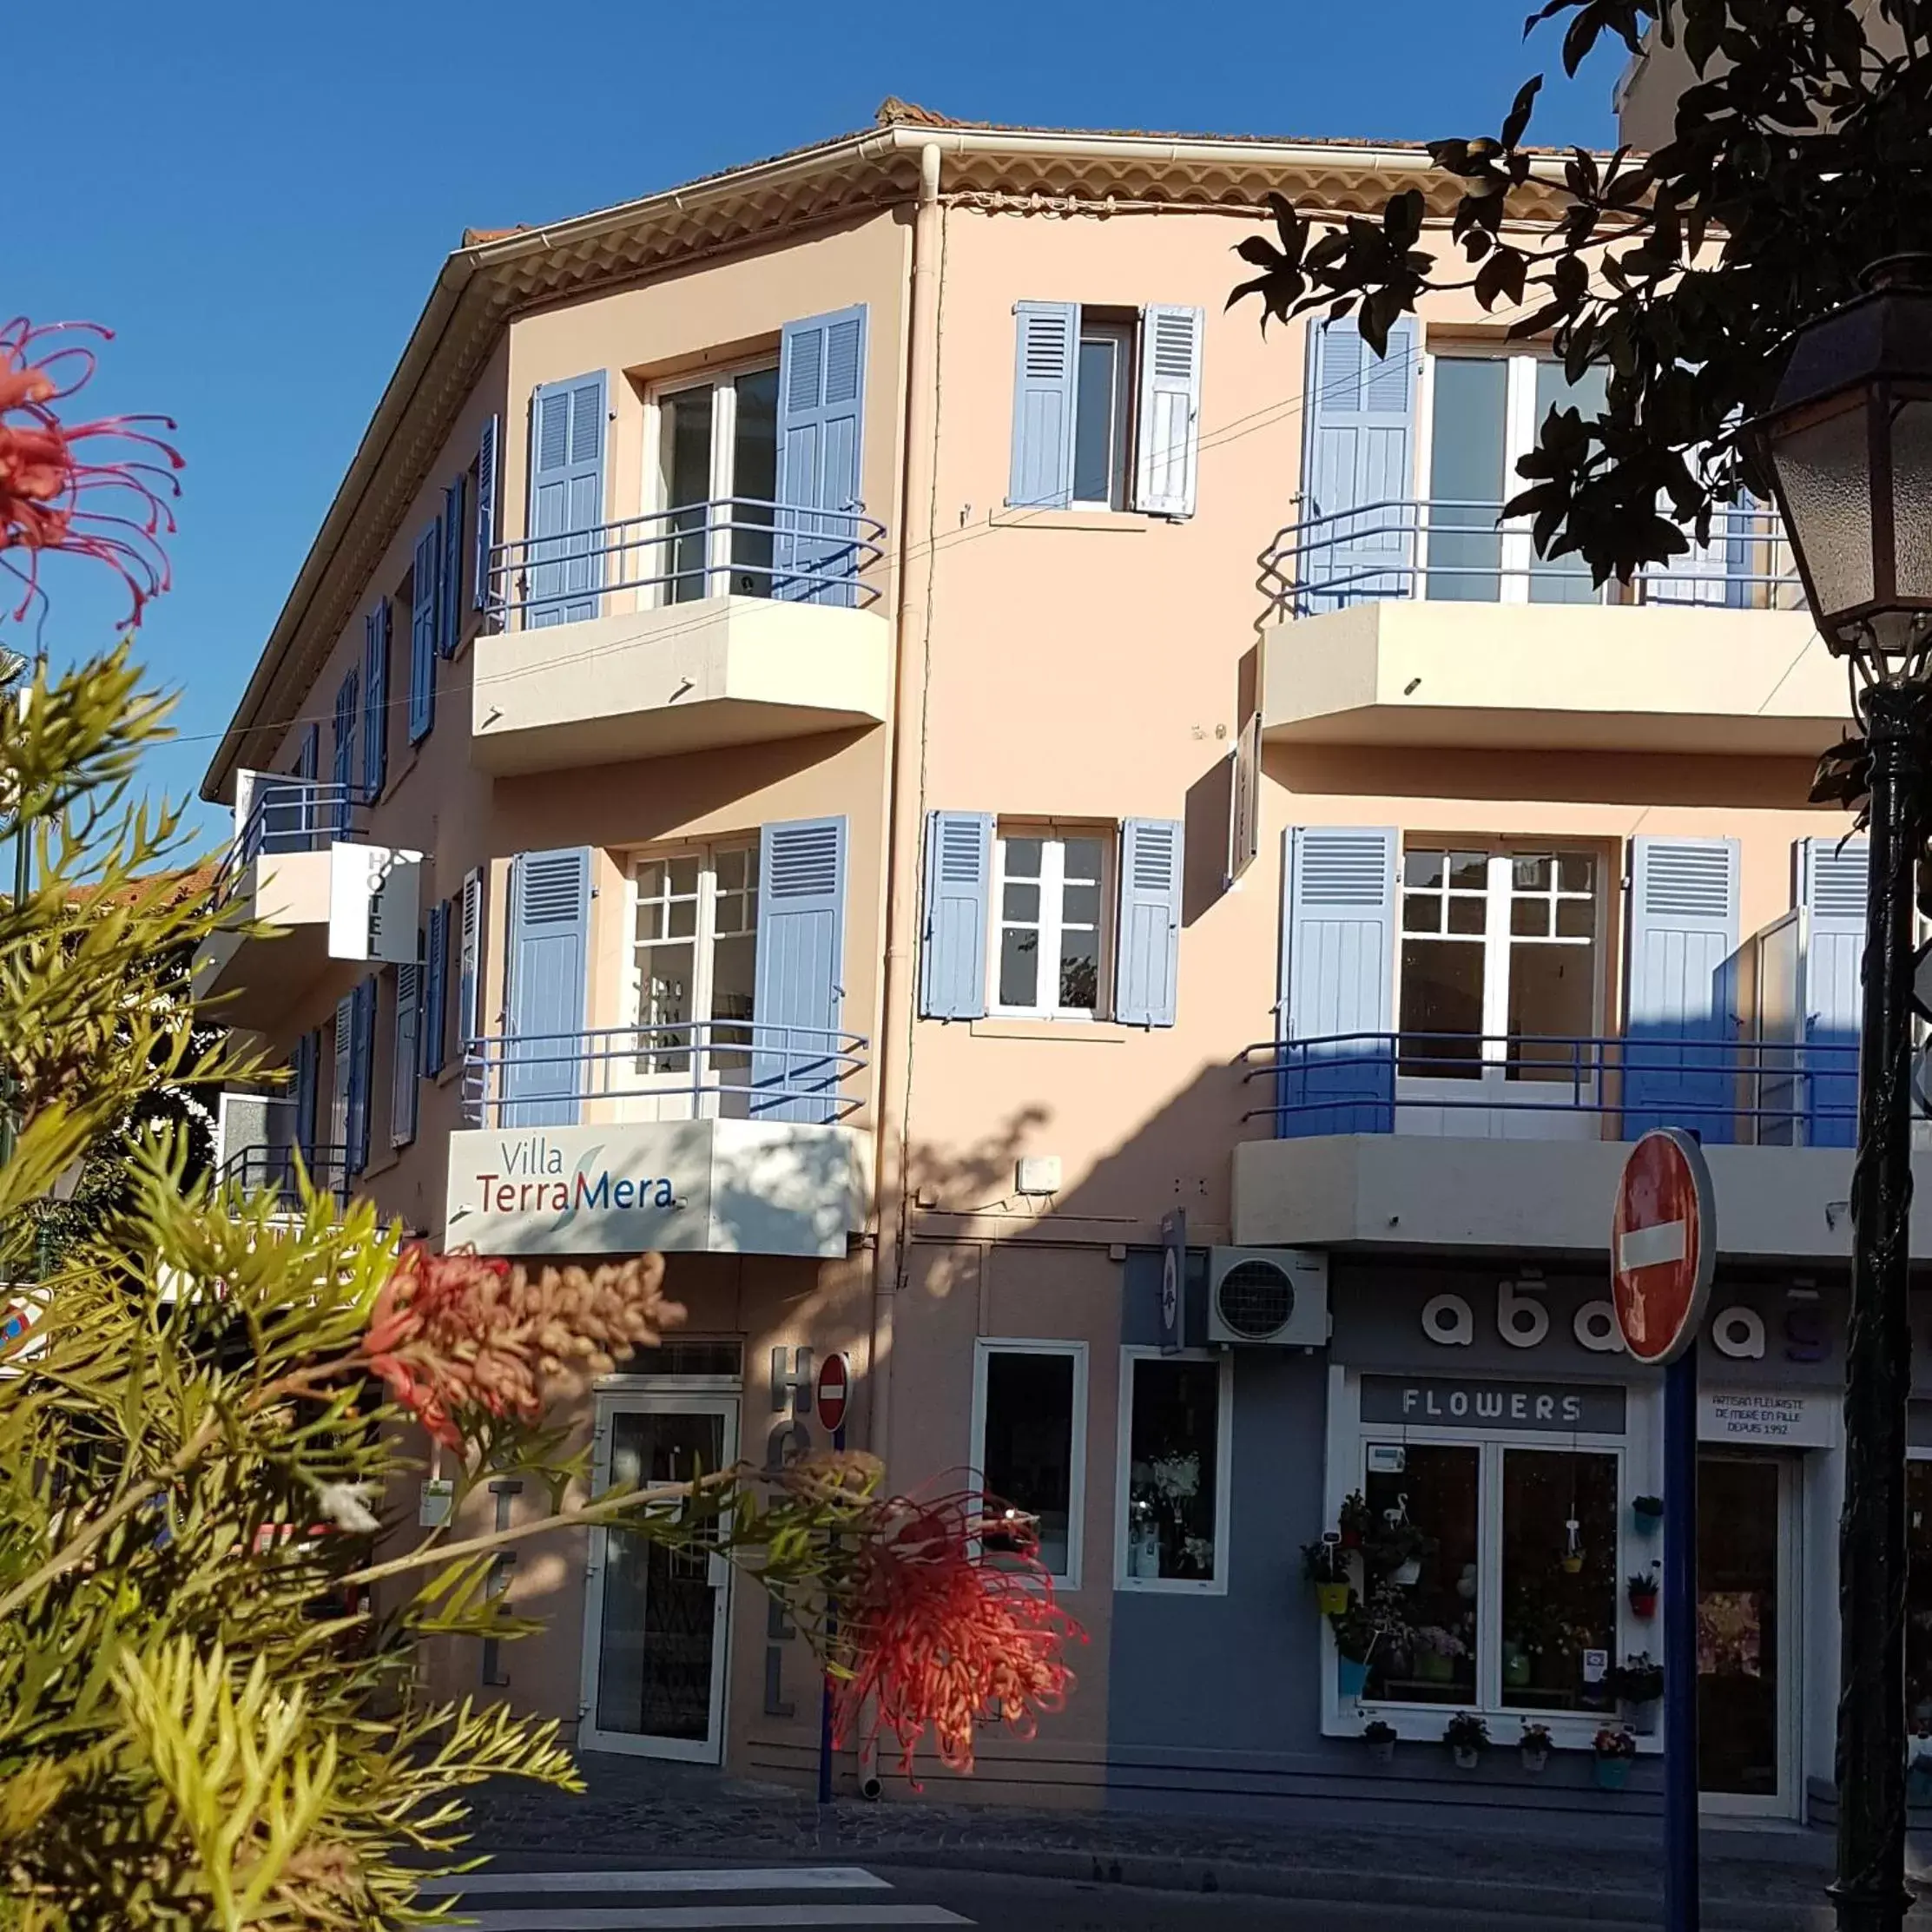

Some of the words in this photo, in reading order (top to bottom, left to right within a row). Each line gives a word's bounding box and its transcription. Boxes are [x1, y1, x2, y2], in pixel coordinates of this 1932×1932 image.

[368, 852, 386, 957] HOTEL
[501, 1137, 563, 1176] Villa
[476, 1171, 674, 1213] TerraMera
[1421, 1282, 1827, 1362] abaas
[1402, 1388, 1581, 1421] FLOWERS
[1716, 1409, 1728, 1419] DE
[1728, 1422, 1761, 1433] DEPUIS
